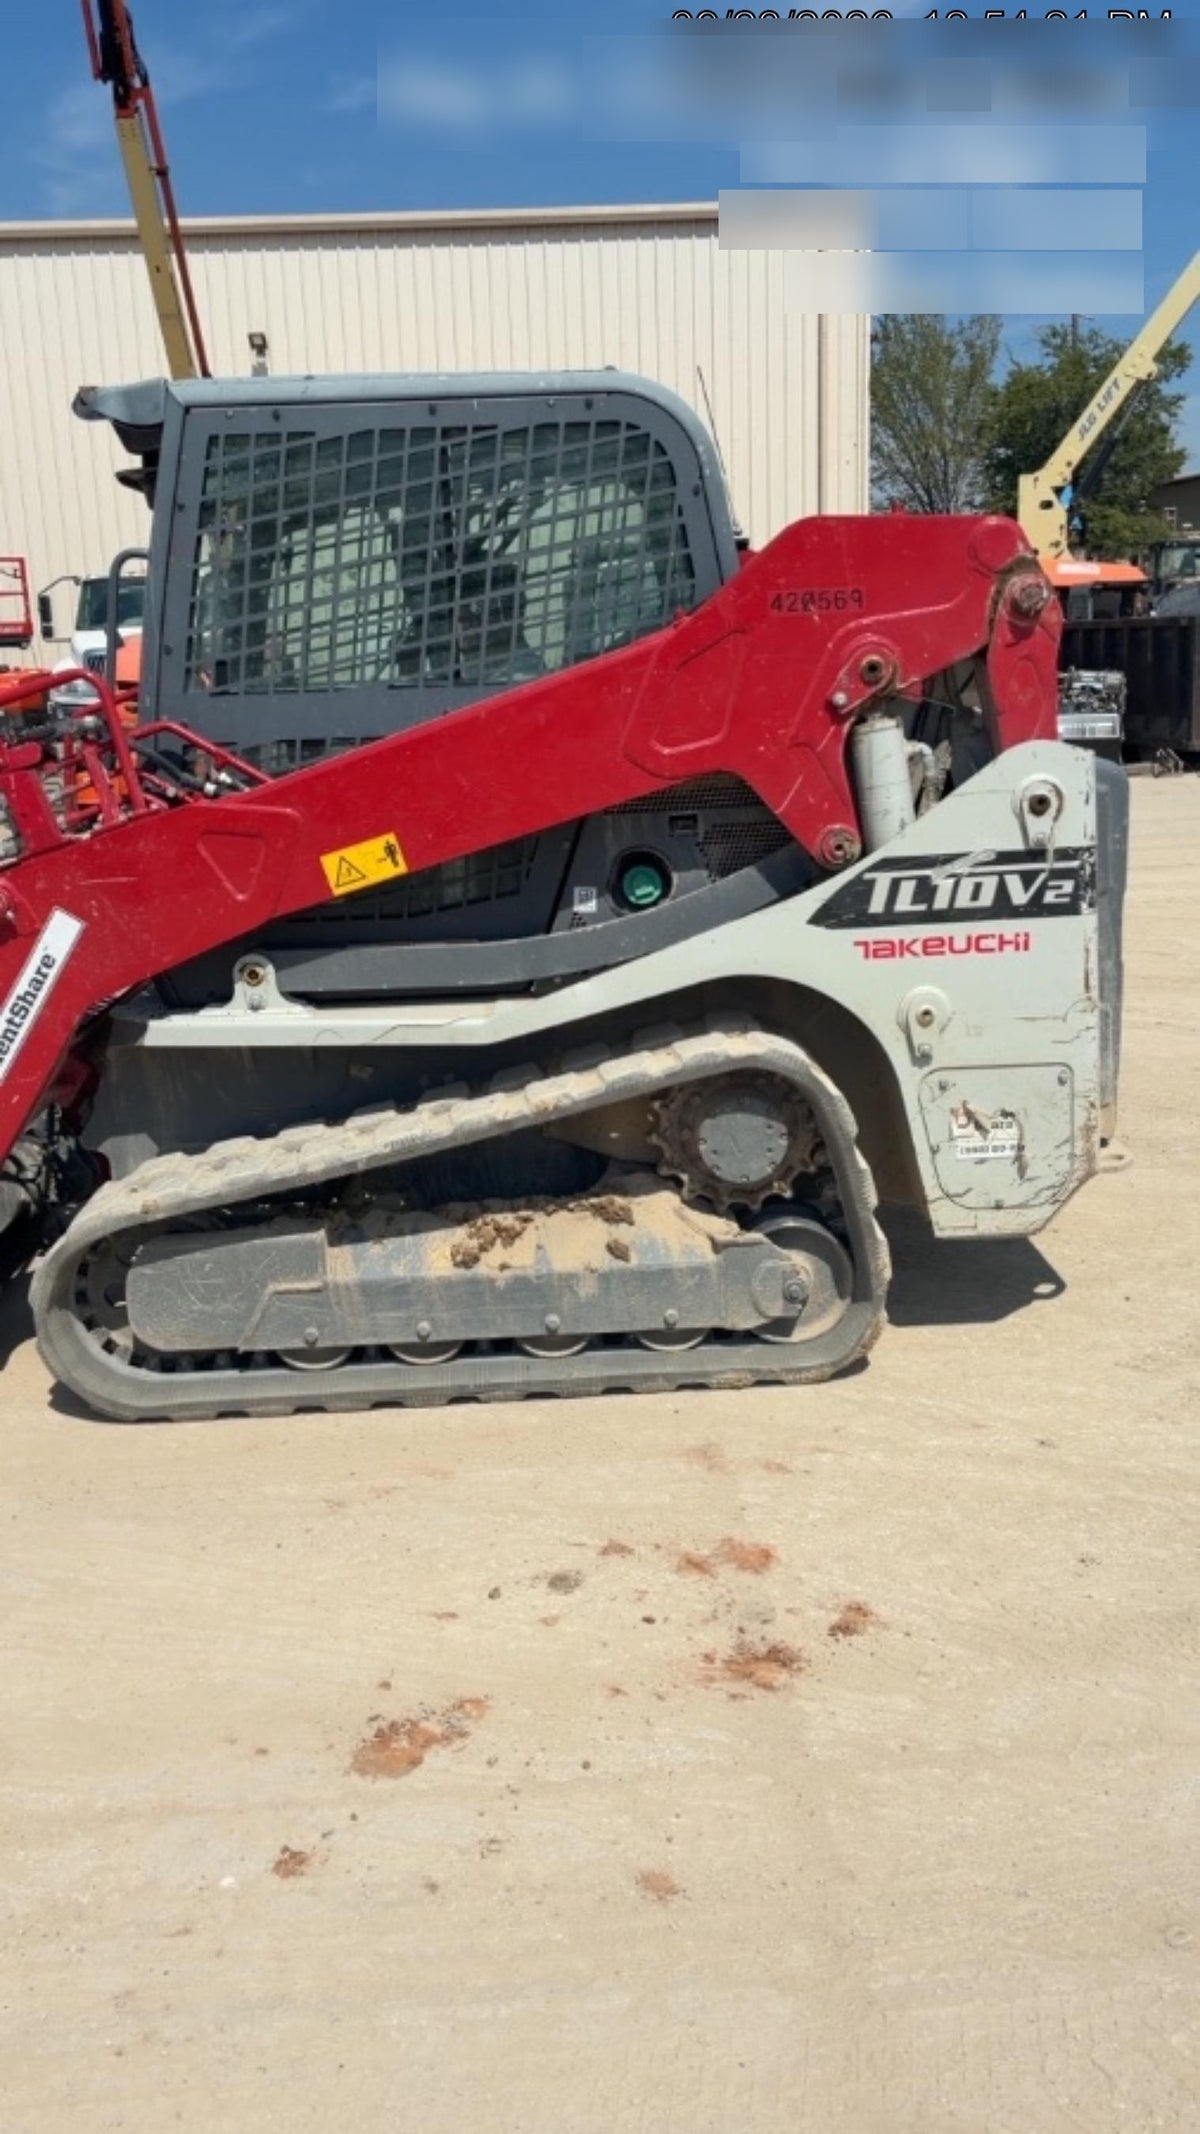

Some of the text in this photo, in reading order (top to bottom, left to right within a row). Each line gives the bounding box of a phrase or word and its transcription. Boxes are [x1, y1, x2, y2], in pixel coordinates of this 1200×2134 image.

[1079, 378, 1120, 440] JLG LIFT
[770, 587, 864, 612] 420569
[0, 951, 57, 1065] entShare
